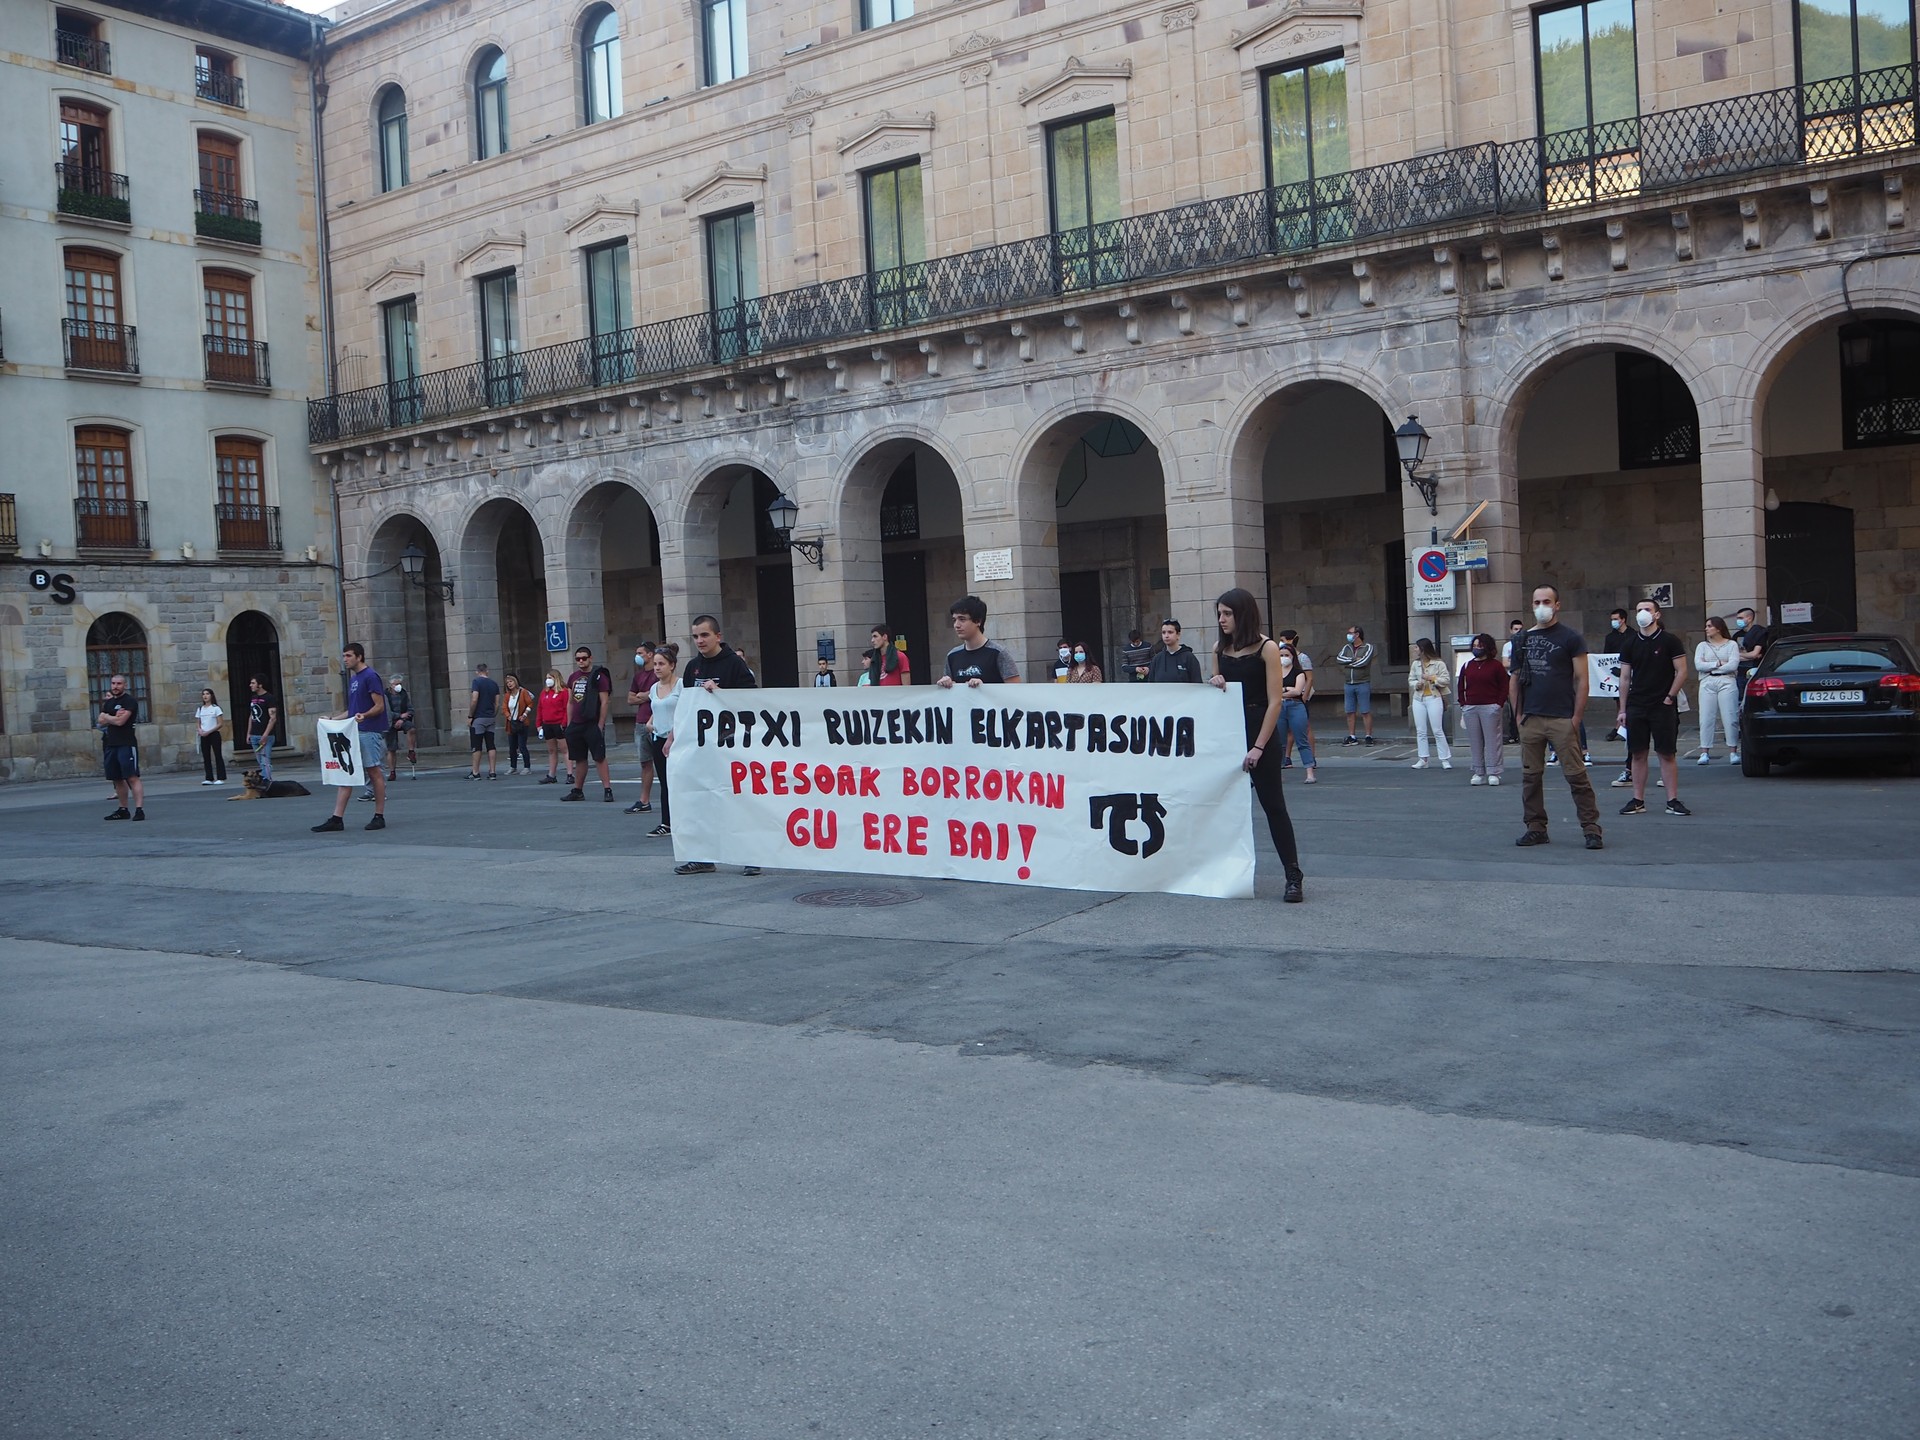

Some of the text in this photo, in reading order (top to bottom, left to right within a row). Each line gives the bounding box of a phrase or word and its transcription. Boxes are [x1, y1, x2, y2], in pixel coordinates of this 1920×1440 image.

[1540, 640, 1561, 653] CITY
[1809, 691, 1860, 701] 4324 GJS
[697, 707, 1195, 758] PATXI RUIZEKIN ELKARTASUNA
[730, 761, 1064, 809] PRESOAK BORROKAN
[786, 808, 1037, 880] GU ERE BAI!
